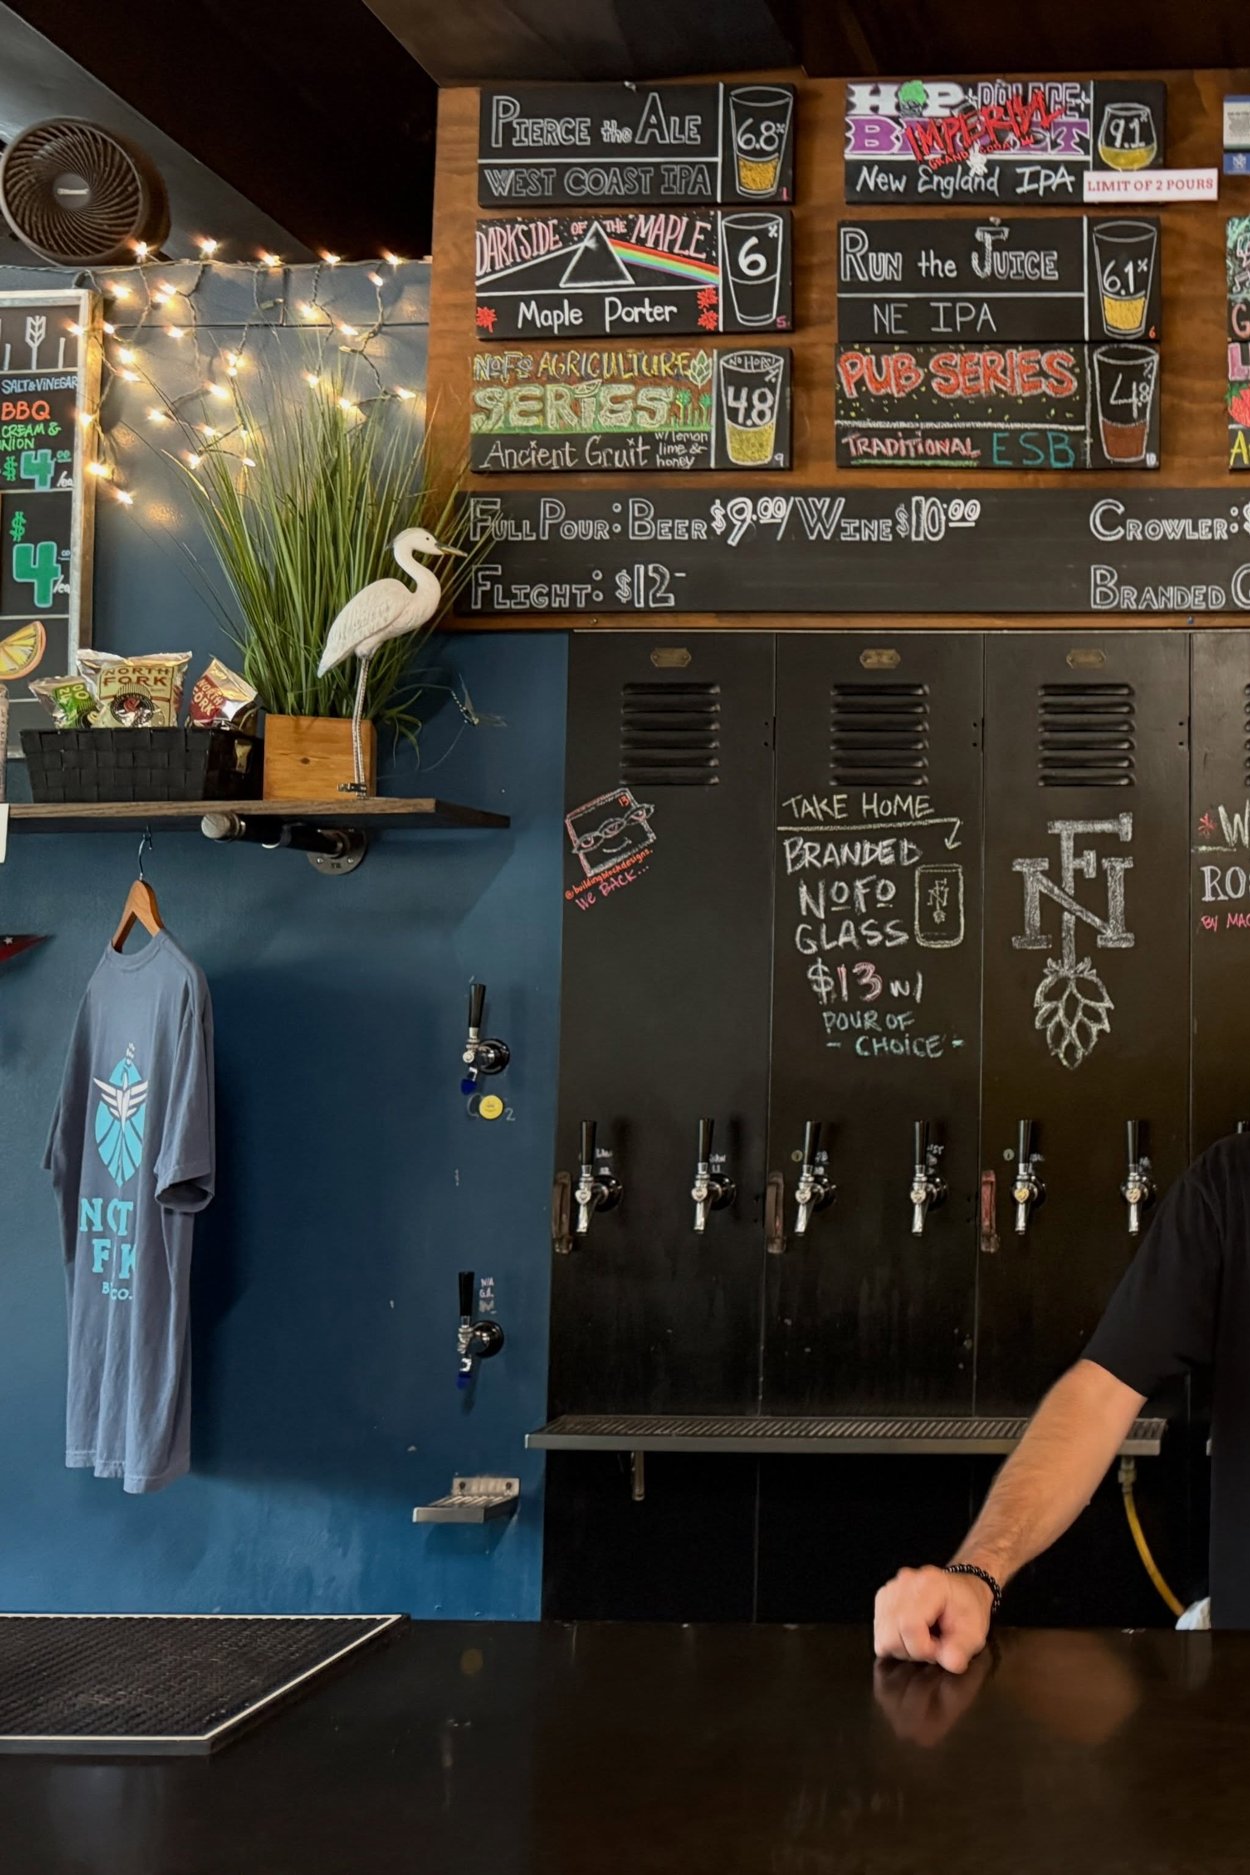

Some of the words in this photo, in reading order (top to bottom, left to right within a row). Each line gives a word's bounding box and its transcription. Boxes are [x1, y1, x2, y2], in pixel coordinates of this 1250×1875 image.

[491, 94, 591, 147] PIERCE
[600, 119, 632, 144] the
[635, 92, 702, 146] ALE
[484, 166, 557, 197] WEST
[563, 165, 655, 196] COAST
[660, 164, 713, 196] IPA
[856, 163, 907, 193] New
[917, 163, 1000, 199] England
[1014, 163, 1077, 197] IPA
[1086, 178, 1134, 193] LIMIT
[1134, 178, 1152, 192] OF
[1156, 177, 1164, 191] 2
[1167, 176, 1215, 192] POURS
[475, 218, 563, 277] DARKSIDE
[570, 220, 588, 236] OF
[603, 219, 628, 233] THE
[630, 213, 713, 259] MAPLE
[840, 227, 903, 282] RUN
[917, 249, 958, 279] the
[970, 225, 1060, 282] JUICE
[517, 300, 584, 334] Maple
[604, 296, 679, 334] Porter
[872, 303, 909, 335] NE
[930, 302, 998, 333] IPA
[538, 350, 692, 380] AGRICULTURE
[837, 349, 925, 398] PUB
[929, 347, 1079, 400] SERIES
[1, 400, 51, 421] BBQ
[472, 379, 674, 432] SERIES
[1, 422, 46, 438] CREAM
[47, 421, 62, 437] &
[669, 430, 709, 443] lemon
[478, 435, 579, 470] Ancient
[585, 435, 652, 468] Gruit
[655, 454, 695, 469] honey
[658, 442, 688, 455] lime
[841, 430, 982, 459] TRADITIONAL
[991, 431, 1077, 469] ESB
[470, 497, 537, 541] FULL
[540, 497, 622, 541] POUR:
[629, 497, 708, 541] BEER
[1089, 498, 1239, 542] CROWLER:
[472, 564, 604, 610] FLIGHT:
[1090, 564, 1226, 611] BRANDED
[102, 665, 170, 677] NORTH
[102, 675, 168, 689] FORK
[197, 677, 223, 706] NORTH
[782, 793, 849, 820] TAKE
[862, 793, 936, 819] HOME
[783, 837, 924, 875] BRANDED
[795, 918, 910, 957] GLASS
[807, 957, 883, 1005] $13
[822, 1010, 882, 1033] POUR
[884, 1009, 916, 1031] OF
